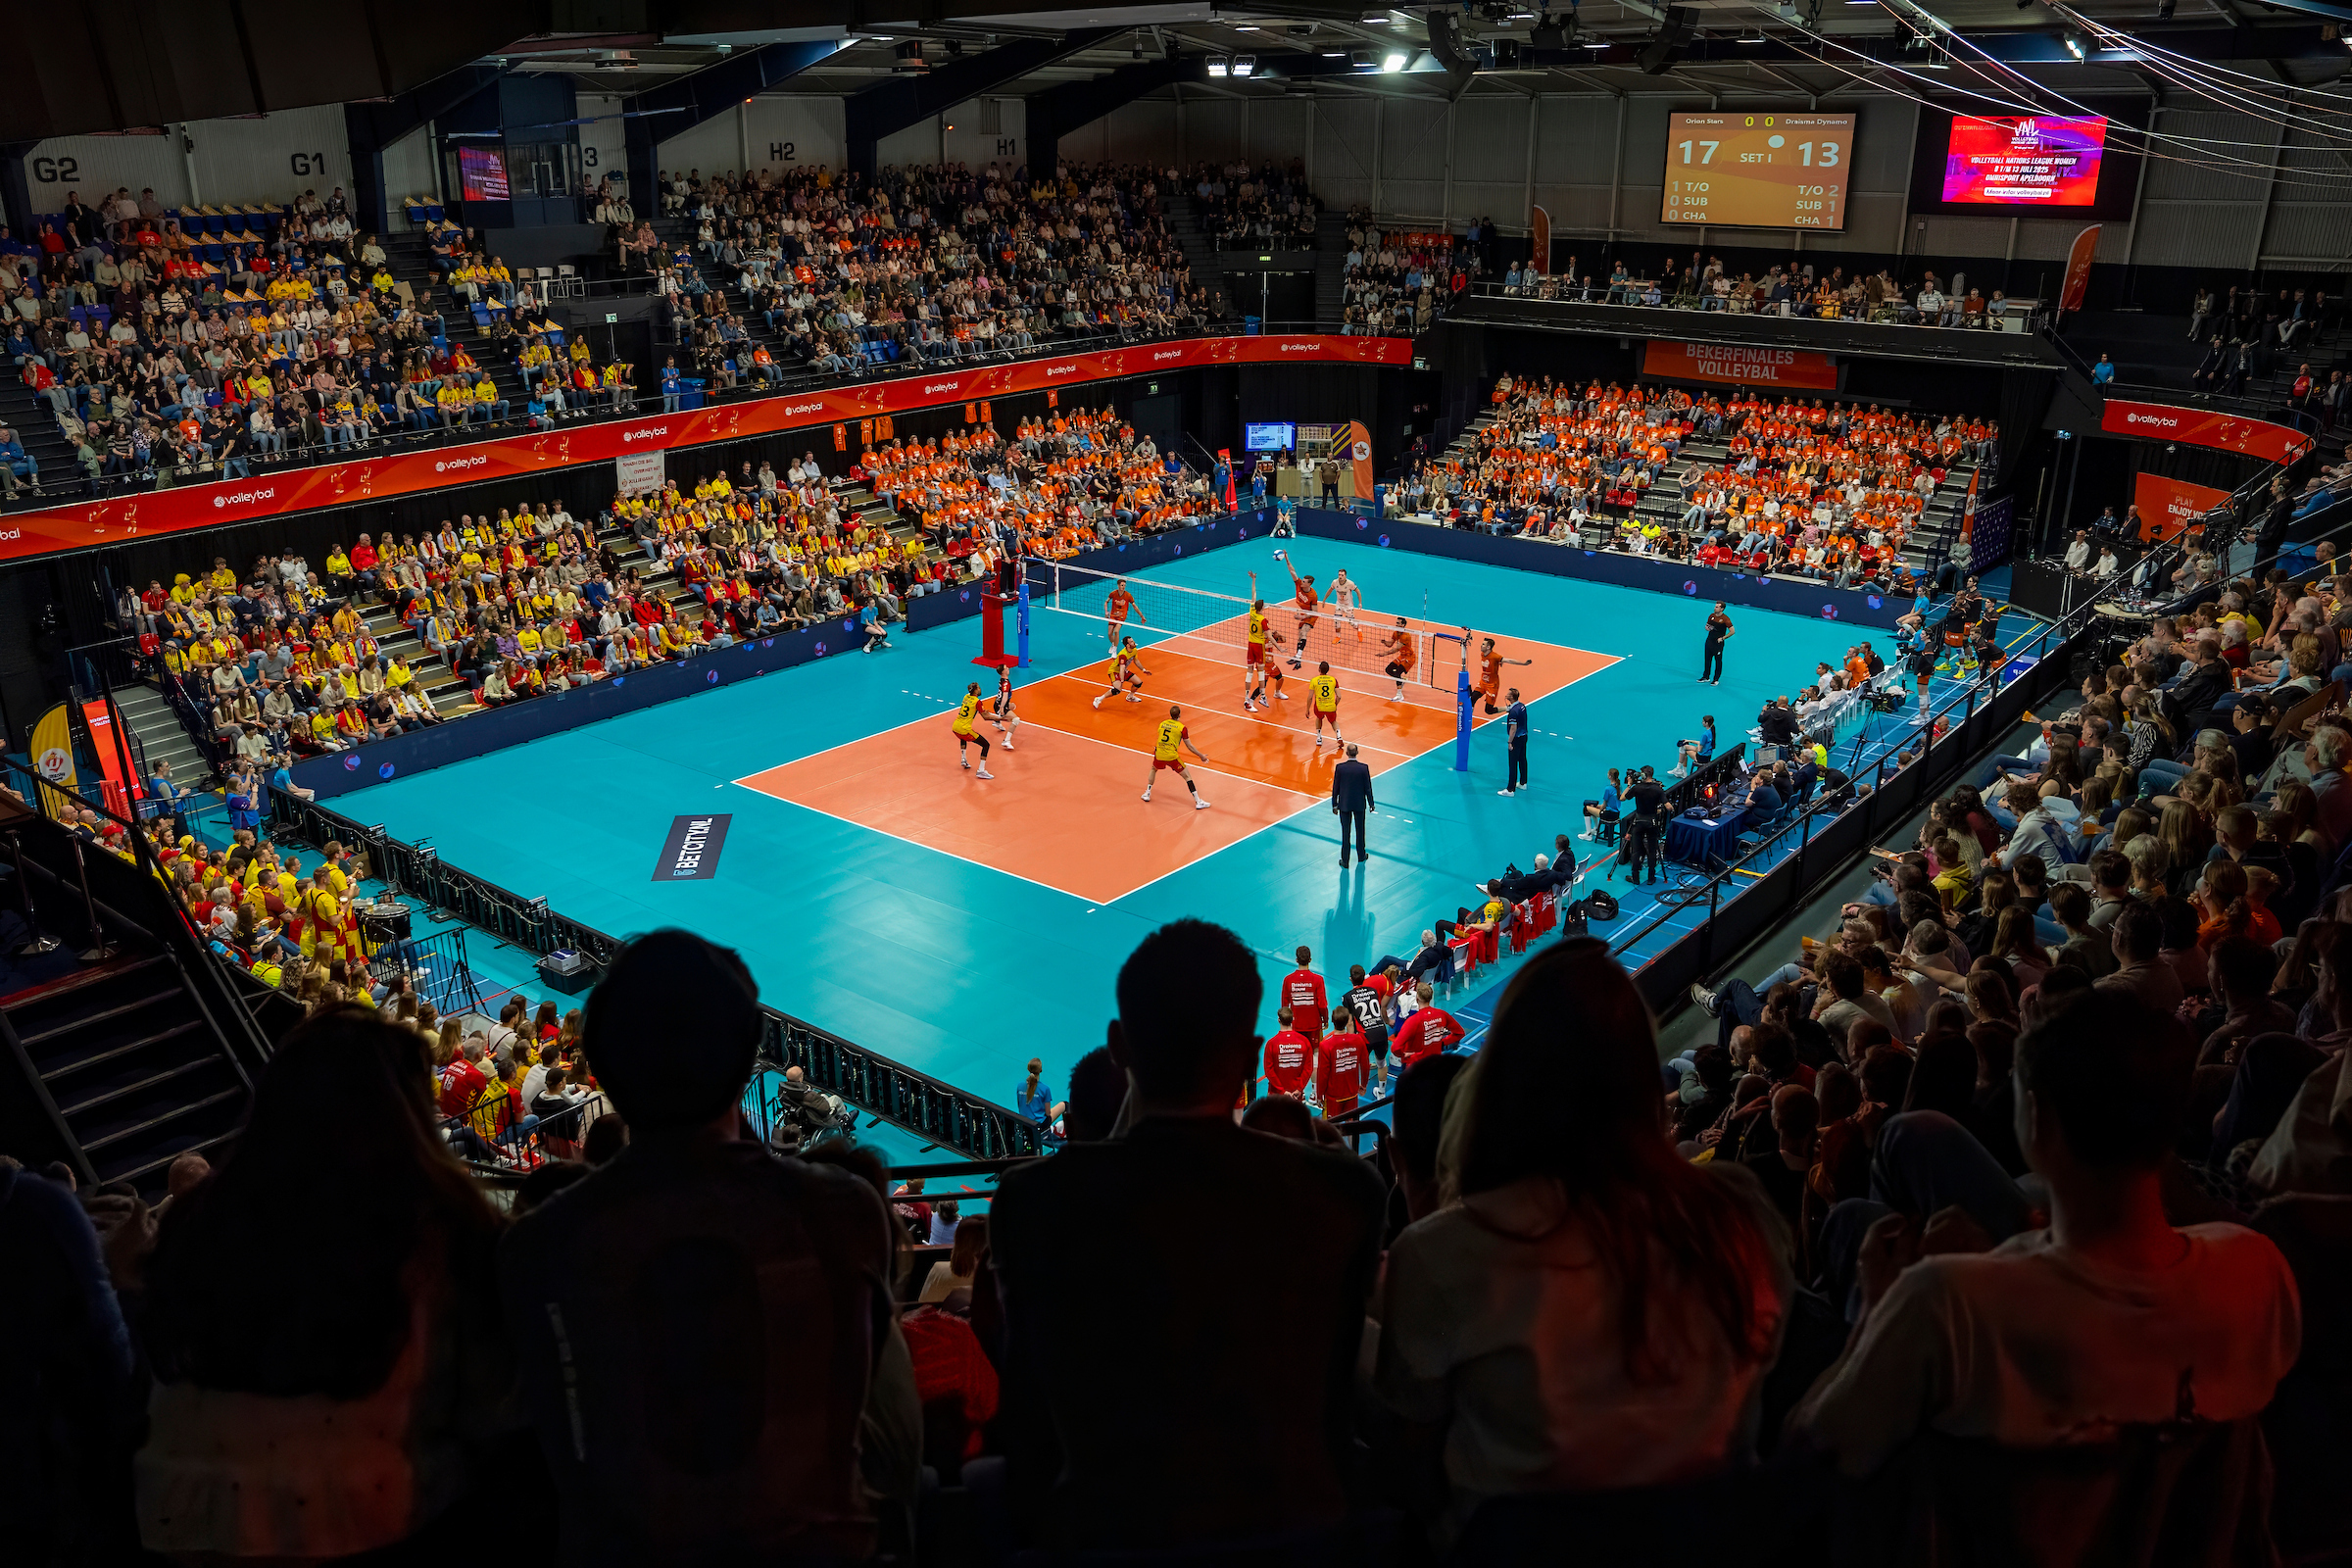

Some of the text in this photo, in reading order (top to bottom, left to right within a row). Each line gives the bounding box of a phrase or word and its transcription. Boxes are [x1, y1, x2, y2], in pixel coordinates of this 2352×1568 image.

[1745, 116, 1774, 127] 0 0
[770, 142, 795, 161] H2
[997, 139, 1015, 155] H1
[1679, 140, 1719, 164] 17
[1740, 153, 1764, 163] SET
[1798, 142, 1839, 167] 13
[33, 158, 80, 182] G2
[291, 153, 325, 176] G1
[1672, 181, 1710, 193] 1 T/O
[1798, 185, 1839, 197] T/O 2
[1669, 195, 1708, 206] 0 SUB
[1796, 200, 1836, 212] SUB 1
[1668, 210, 1707, 220] 0 CHA
[1794, 215, 1834, 227] CHA 1
[1288, 343, 1320, 352] volleybal
[1158, 350, 1181, 359] volleybal
[1686, 343, 1794, 365] BEKERFINALES
[1052, 365, 1076, 374] volleybal
[1698, 360, 1778, 380] VOLLEYBAL
[931, 381, 958, 393] volleybal
[792, 402, 823, 414] volleybal
[2137, 416, 2178, 427] volleybal
[632, 426, 667, 440] volleybal
[445, 454, 487, 470] volleybal
[224, 488, 275, 505] volleybal
[2175, 496, 2194, 507] PLAY
[2167, 504, 2193, 517] ENJOY
[1321, 685, 1330, 697] 8
[1161, 729, 1171, 742] 5
[675, 818, 713, 869] BETCITY.NL
[1354, 999, 1380, 1022] 20
